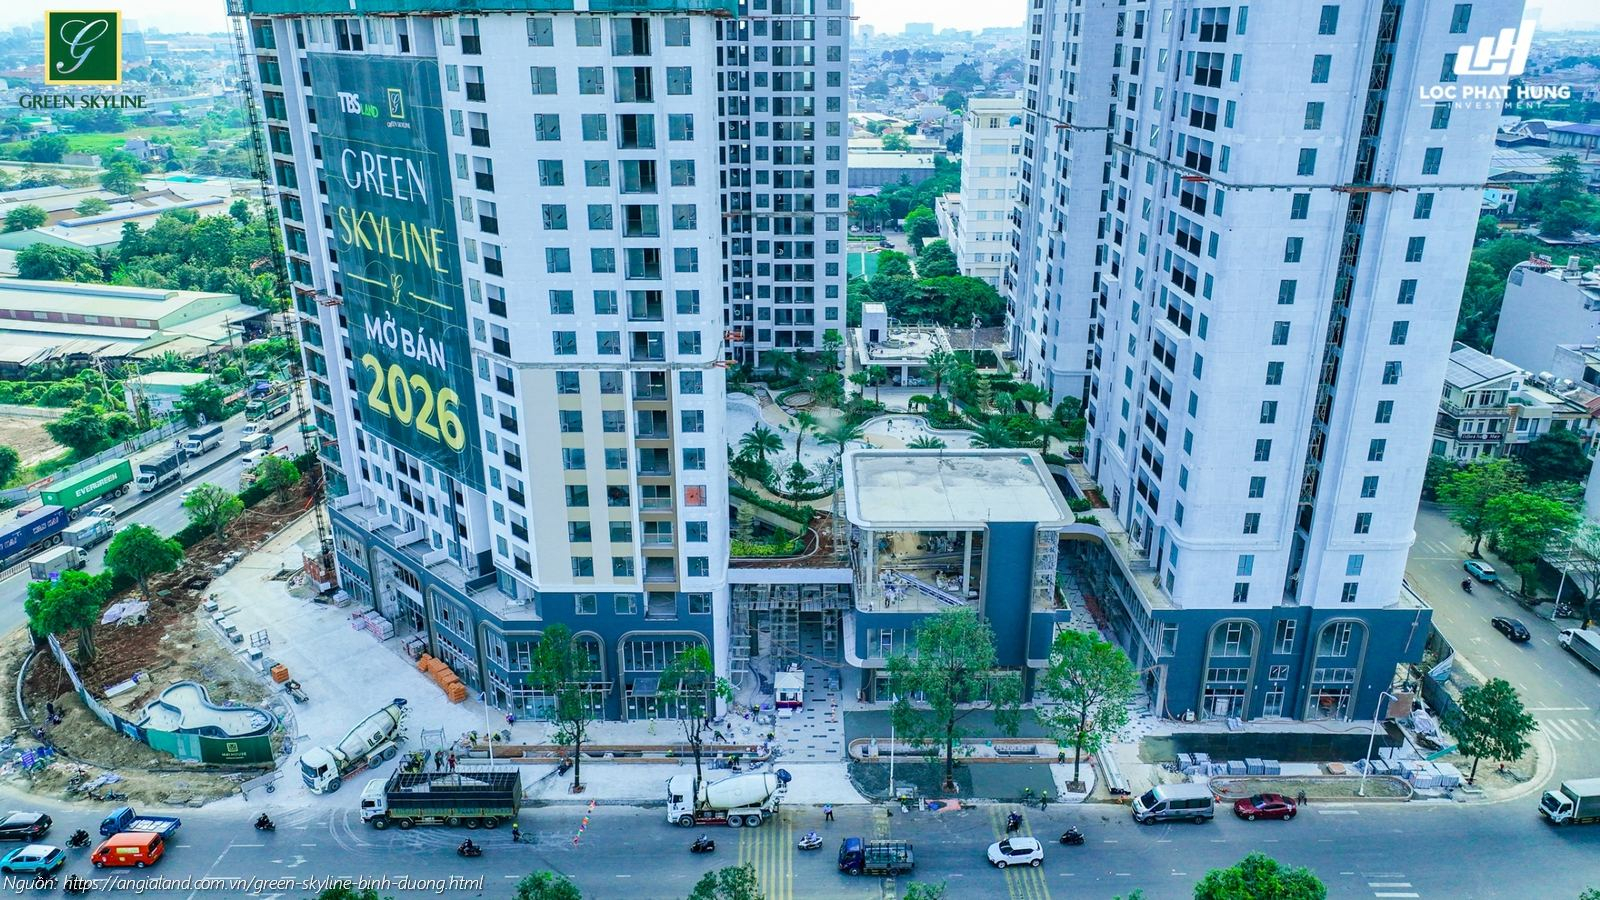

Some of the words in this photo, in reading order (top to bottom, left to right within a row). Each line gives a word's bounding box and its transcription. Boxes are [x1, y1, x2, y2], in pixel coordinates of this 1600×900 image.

[341, 148, 428, 206] GREEN
[338, 205, 449, 274] SKYLINE
[363, 310, 398, 350] MỞ
[400, 327, 447, 372] BÁN
[361, 353, 466, 454] 2026
[75, 472, 118, 498] EVERGREEN
